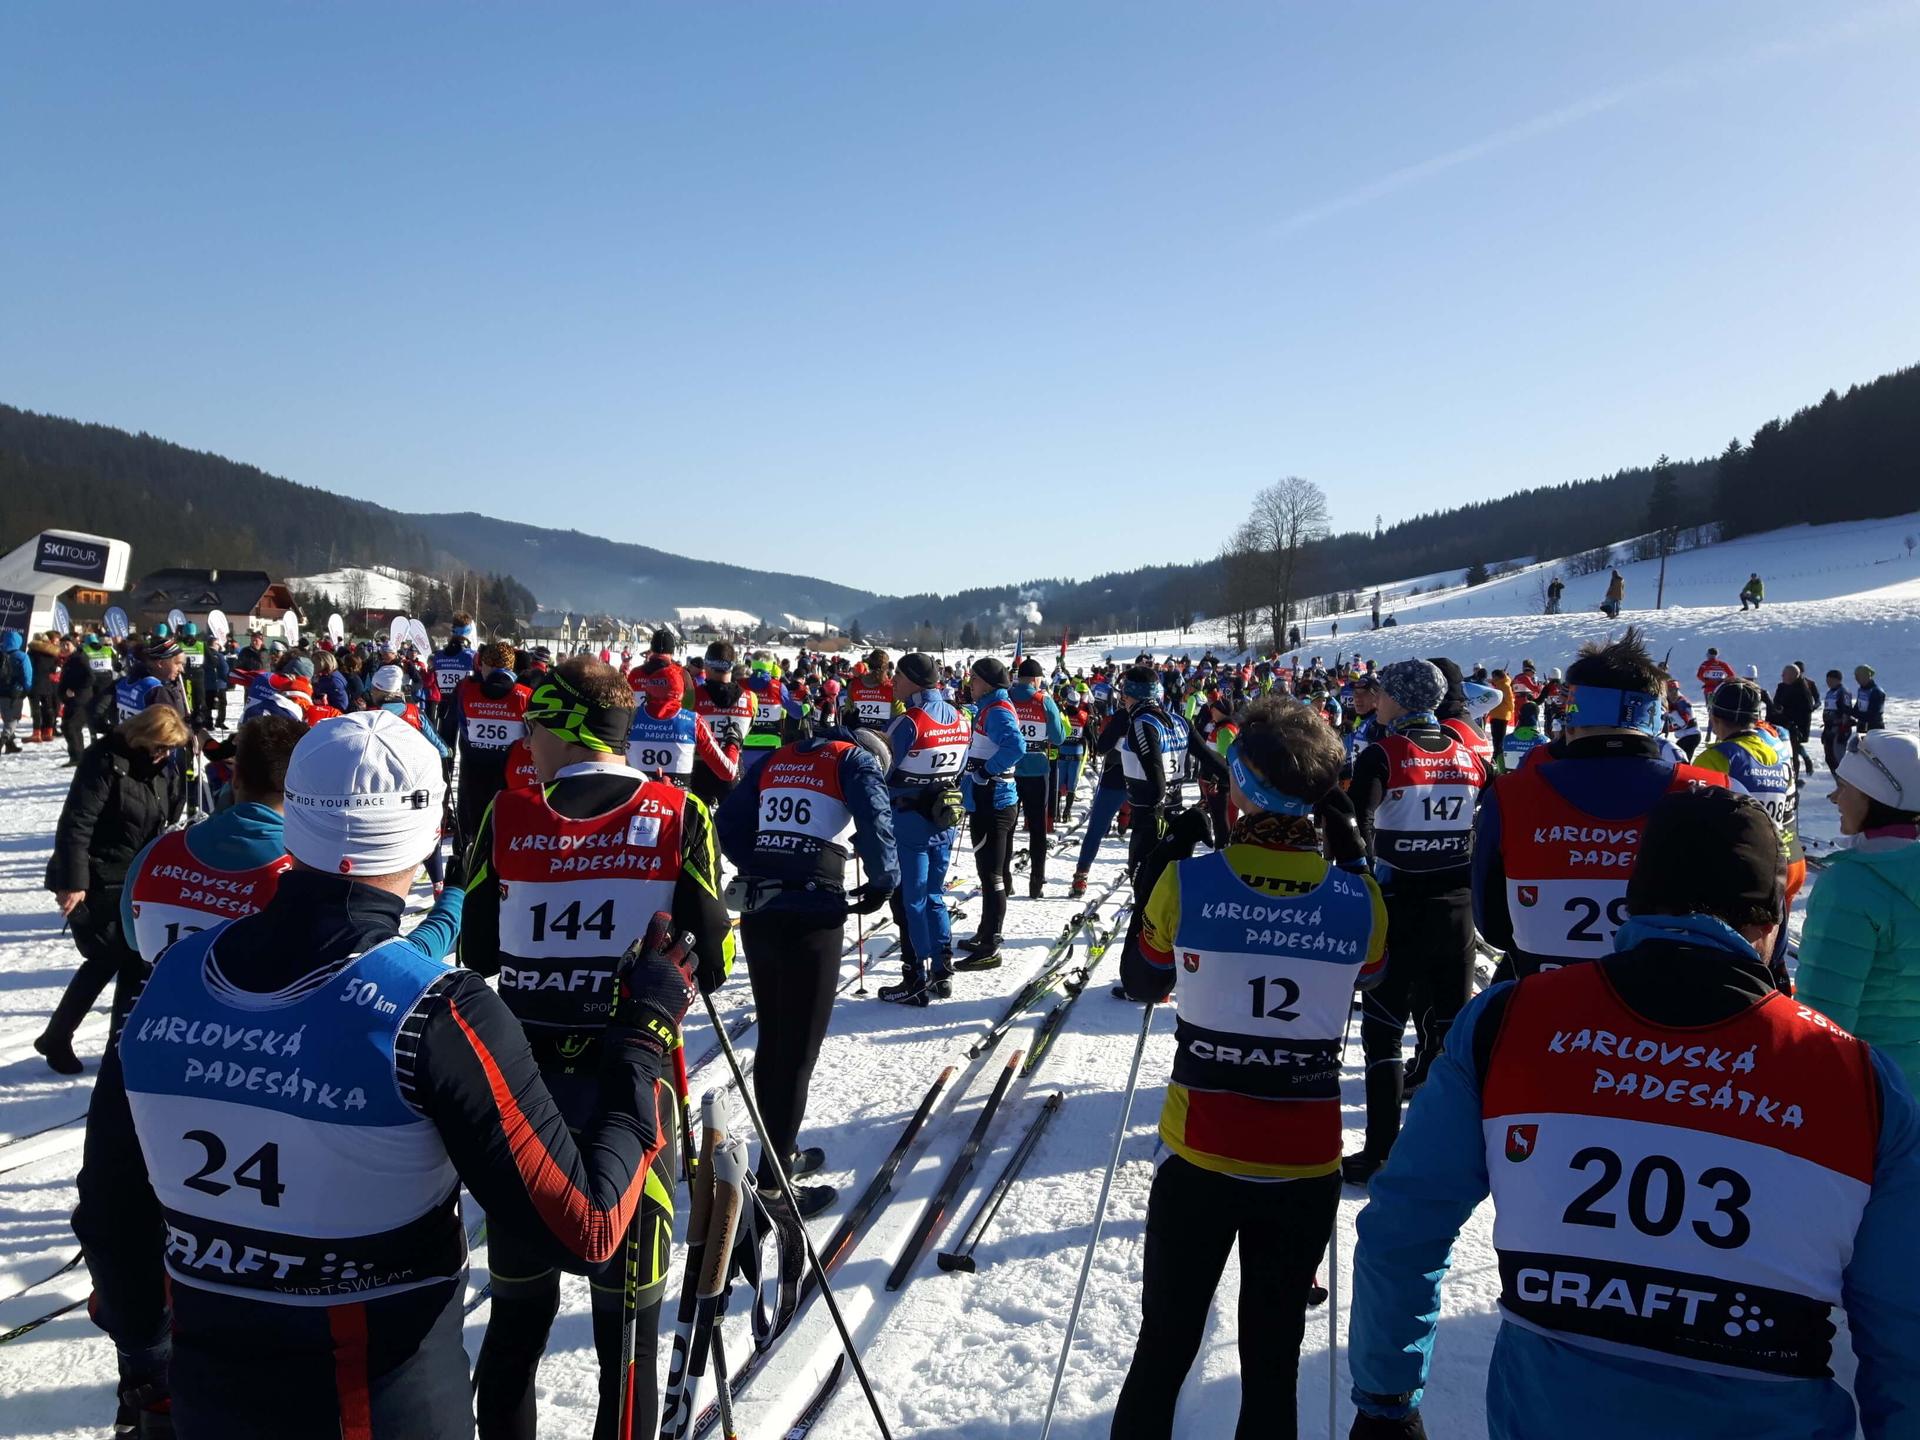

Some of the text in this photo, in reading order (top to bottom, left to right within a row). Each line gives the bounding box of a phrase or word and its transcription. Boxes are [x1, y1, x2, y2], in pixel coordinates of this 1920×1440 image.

[44, 542, 97, 562] SKITOUR
[442, 673, 460, 685] 258
[860, 704, 881, 715] 224
[476, 723, 508, 740] 256
[641, 749, 672, 766] 80
[930, 751, 957, 769] 122
[297, 796, 385, 808] RIDE YOUR RACE
[639, 799, 674, 816] 25 km
[765, 796, 812, 825] 396
[1421, 796, 1464, 821] 147
[509, 827, 625, 851] KARLOVSKÁ
[1394, 837, 1460, 852] CRAFT
[1534, 826, 1638, 844] KARLOVS
[550, 850, 662, 874] PADESÁTKA
[151, 863, 256, 895] KARLOVSKÁ
[1333, 880, 1349, 896] 50
[529, 899, 616, 941] 144
[1202, 902, 1322, 926] KARLOVSKÁ
[1246, 928, 1357, 955] PADESÁTKA
[500, 965, 614, 993] CRAFT
[340, 977, 398, 1014] 50 km
[1247, 975, 1301, 1022] 12
[137, 1016, 307, 1057] KARLOVSKÁ
[1796, 1005, 1857, 1042] 25 km
[1188, 1039, 1316, 1066] CRAFT
[1548, 1029, 1758, 1075] KARLOVSKÁ
[185, 1058, 368, 1111] PADESÁTKA
[1593, 1068, 1804, 1130] PADESÁTKA
[182, 1129, 286, 1208] 24
[1561, 1146, 1753, 1250] 203
[1516, 1268, 1718, 1326] CRAFT
